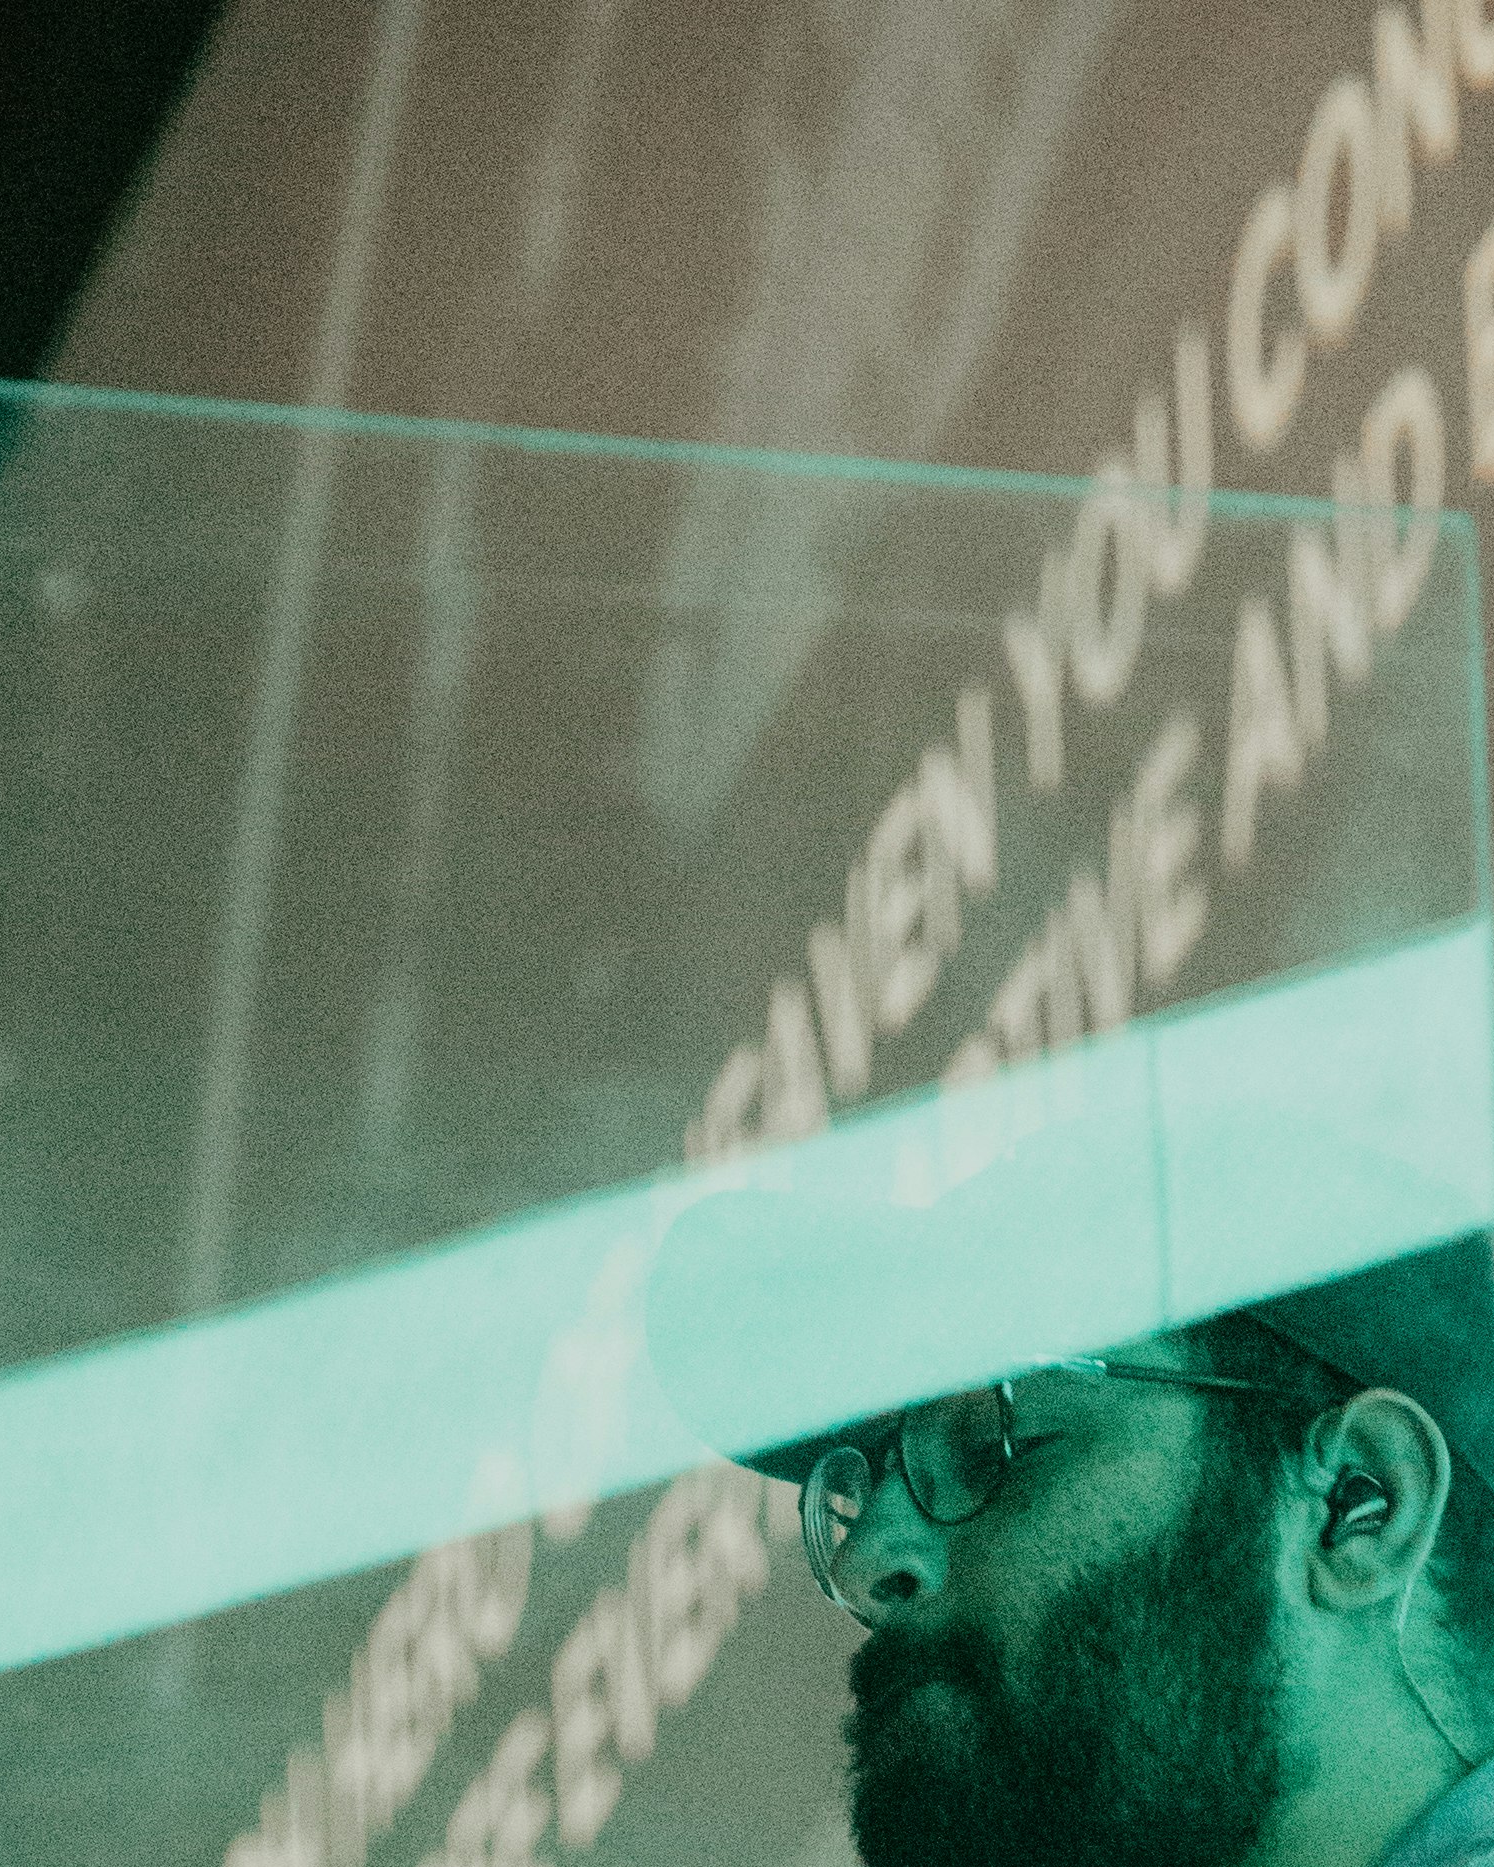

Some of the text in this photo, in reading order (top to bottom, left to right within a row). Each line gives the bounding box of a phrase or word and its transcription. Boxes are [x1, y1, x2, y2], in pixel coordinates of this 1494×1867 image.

[657, 687, 999, 1230] EAVEN
[1002, 318, 1213, 793] YOU
[1223, 364, 1447, 872] AND
